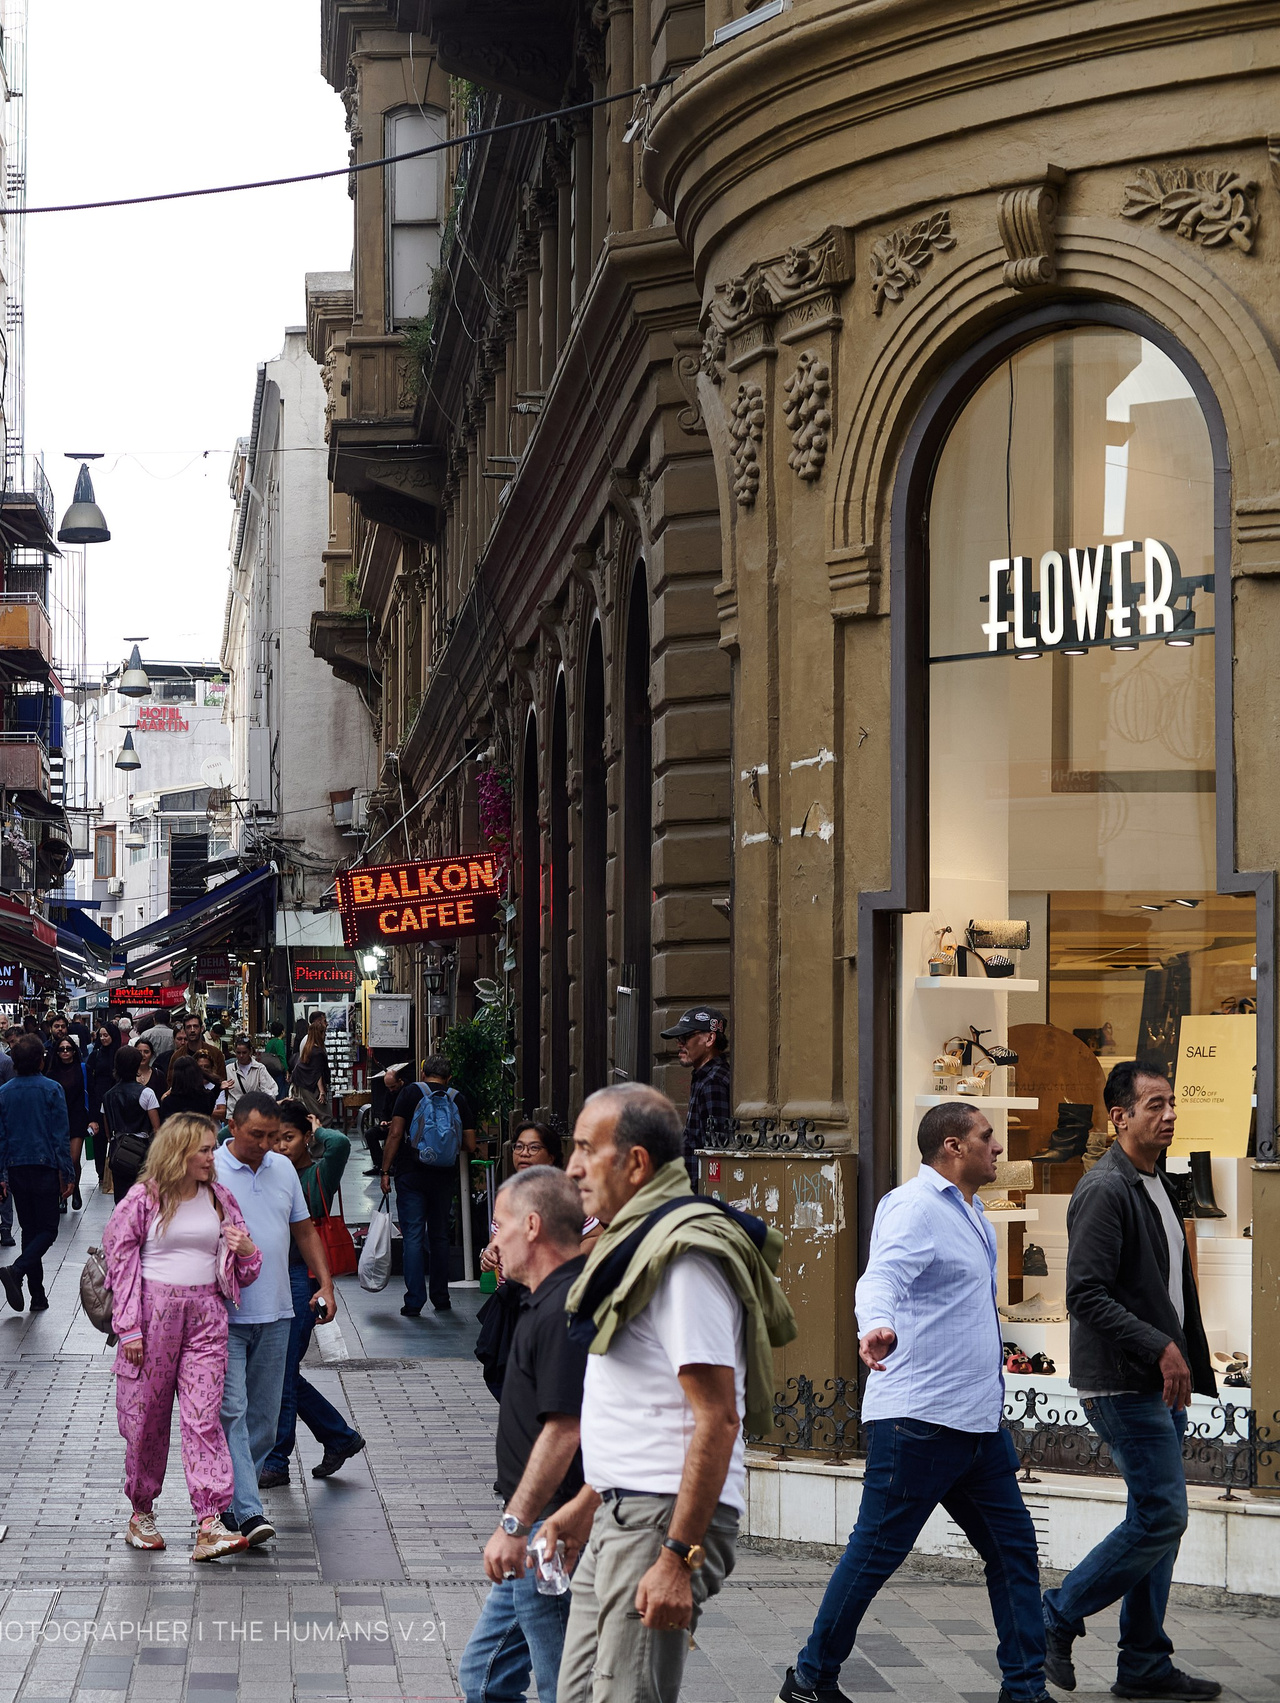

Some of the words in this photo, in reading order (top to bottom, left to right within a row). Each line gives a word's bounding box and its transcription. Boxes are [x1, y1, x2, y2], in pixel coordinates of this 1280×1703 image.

[982, 537, 1182, 651] FLOWER
[139, 707, 183, 719] HOTEL
[136, 719, 189, 732] MARTIN
[352, 860, 495, 904] BALKON
[378, 900, 476, 934] CAFEE
[200, 957, 225, 967] DEHA
[295, 966, 353, 984] Piercing
[1186, 1046, 1217, 1058] SALE
[1181, 1085, 1207, 1098] 30%
